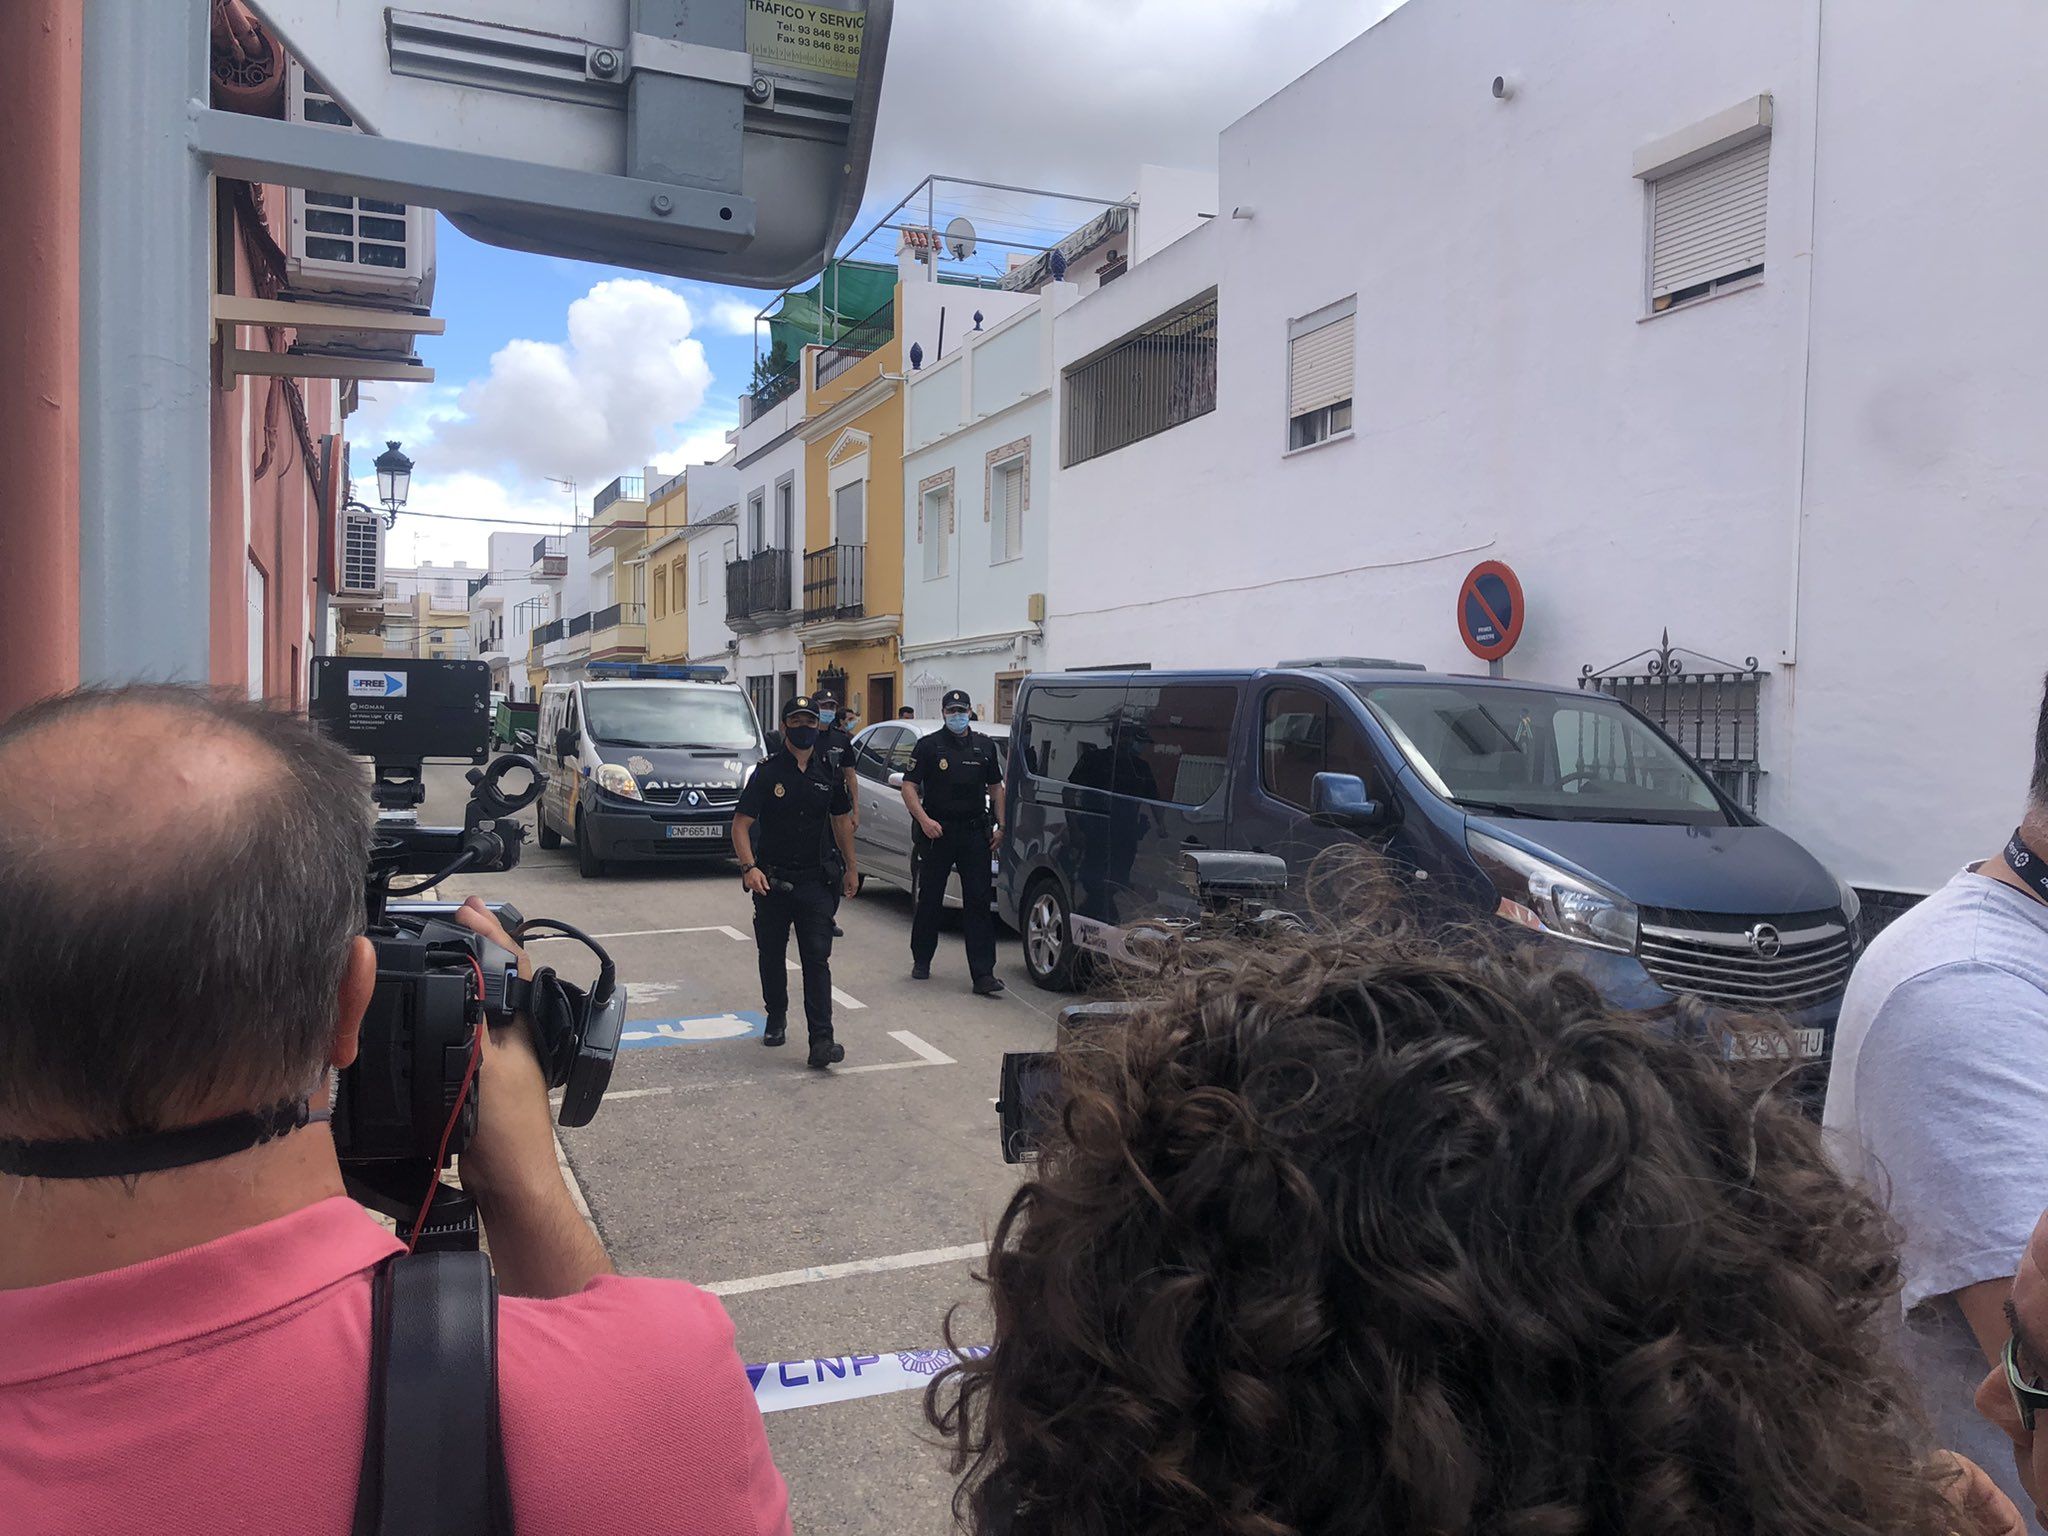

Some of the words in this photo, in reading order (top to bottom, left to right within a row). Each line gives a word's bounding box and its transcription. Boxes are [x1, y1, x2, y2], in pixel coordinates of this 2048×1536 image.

[808, 11, 816, 22] Y
[777, 21, 795, 32] Tel.
[798, 25, 810, 35] 93
[813, 28, 830, 38] 846
[834, 32, 845, 41] 59
[848, 35, 859, 43] 91
[777, 33, 795, 44] Fax
[798, 37, 810, 47] 93
[813, 40, 830, 50] 846
[834, 44, 845, 53] 82
[848, 47, 860, 55] 86
[779, 1354, 880, 1388] CNP
